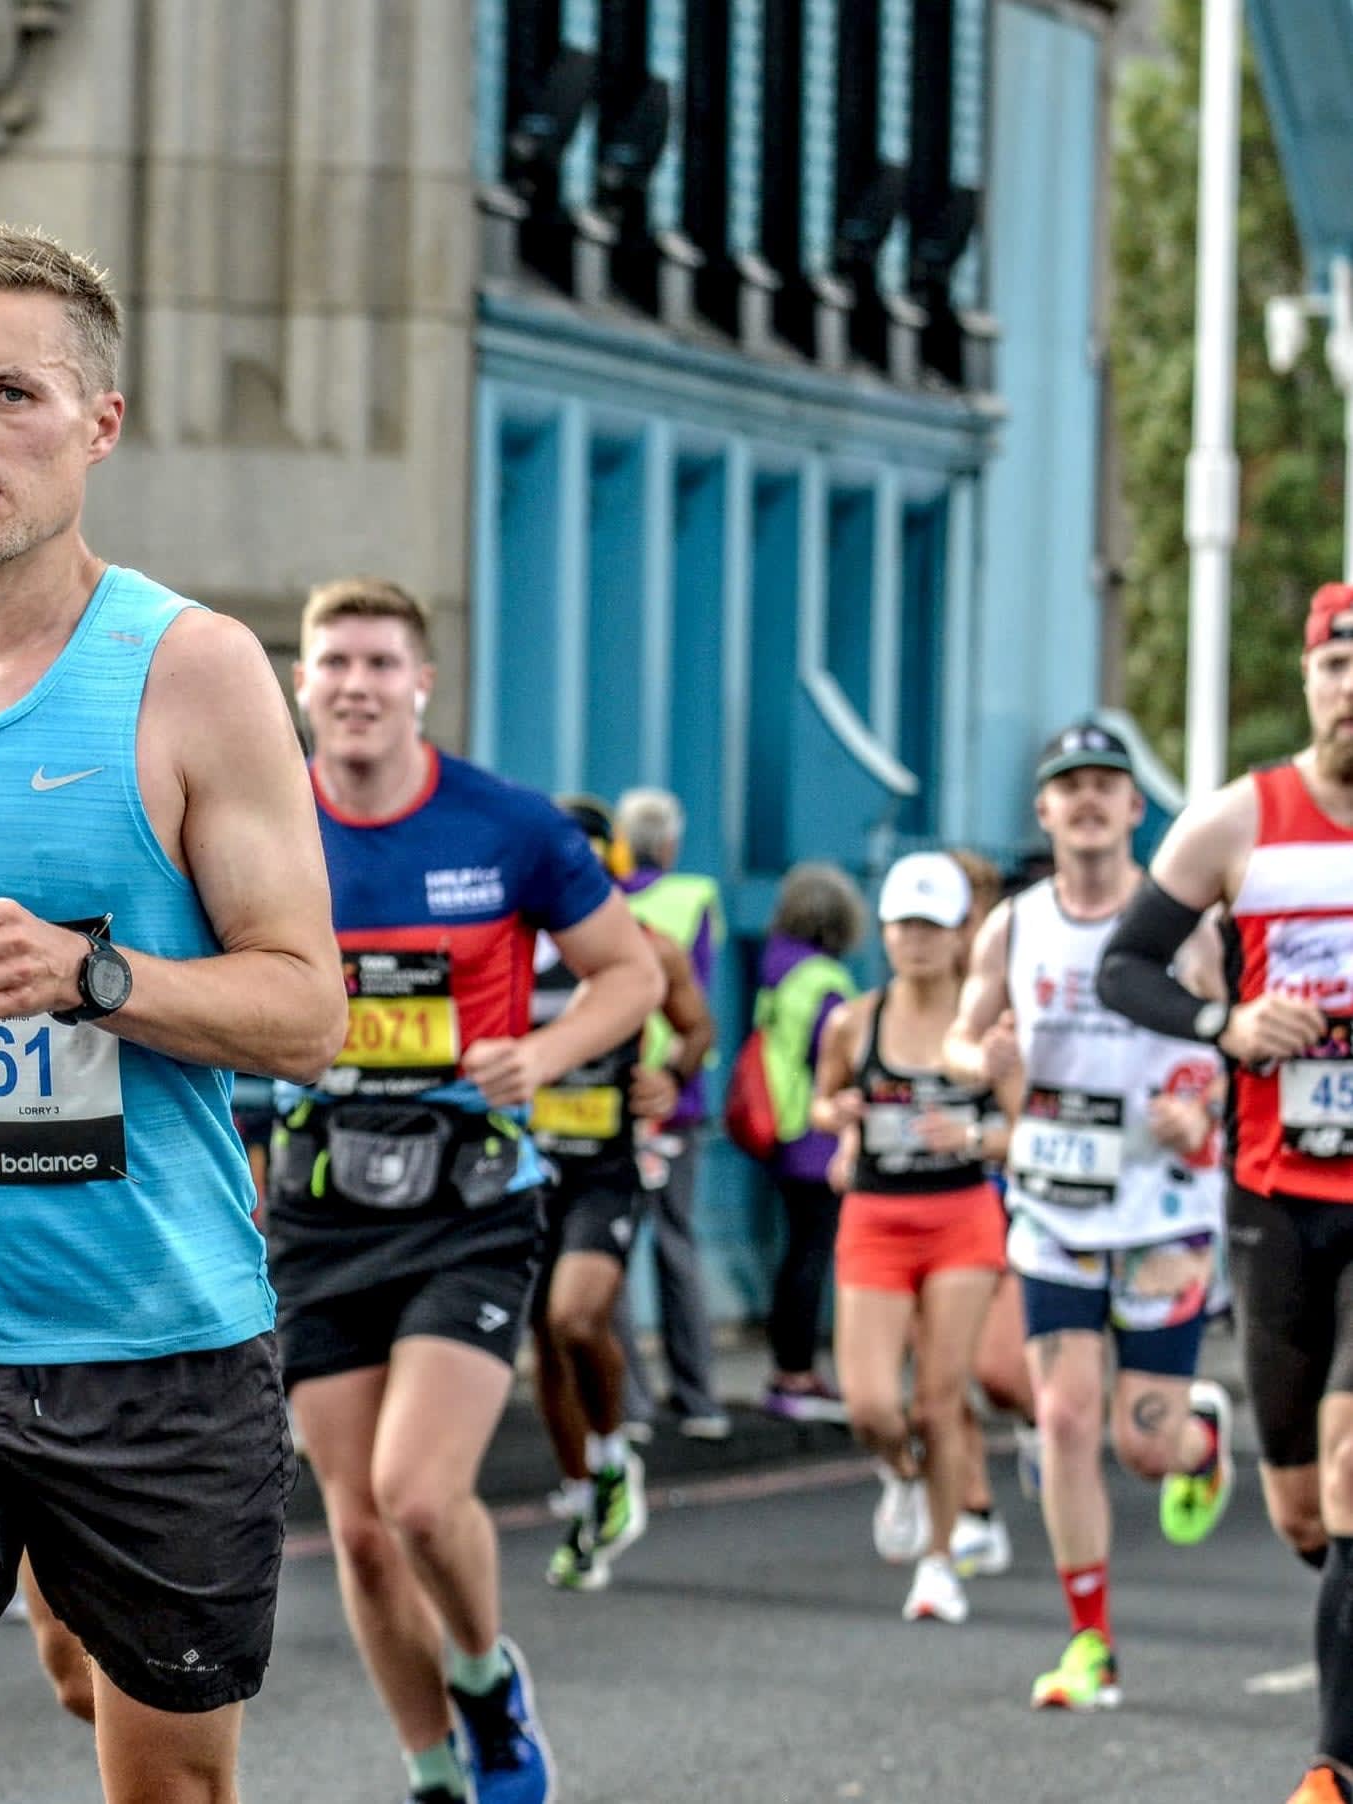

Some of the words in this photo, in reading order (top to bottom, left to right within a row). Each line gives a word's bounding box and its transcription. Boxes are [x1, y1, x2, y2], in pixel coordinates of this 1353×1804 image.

[19, 1107, 52, 1115] LORRY
[54, 1106, 60, 1114] 3
[1, 1152, 98, 1173] balance
